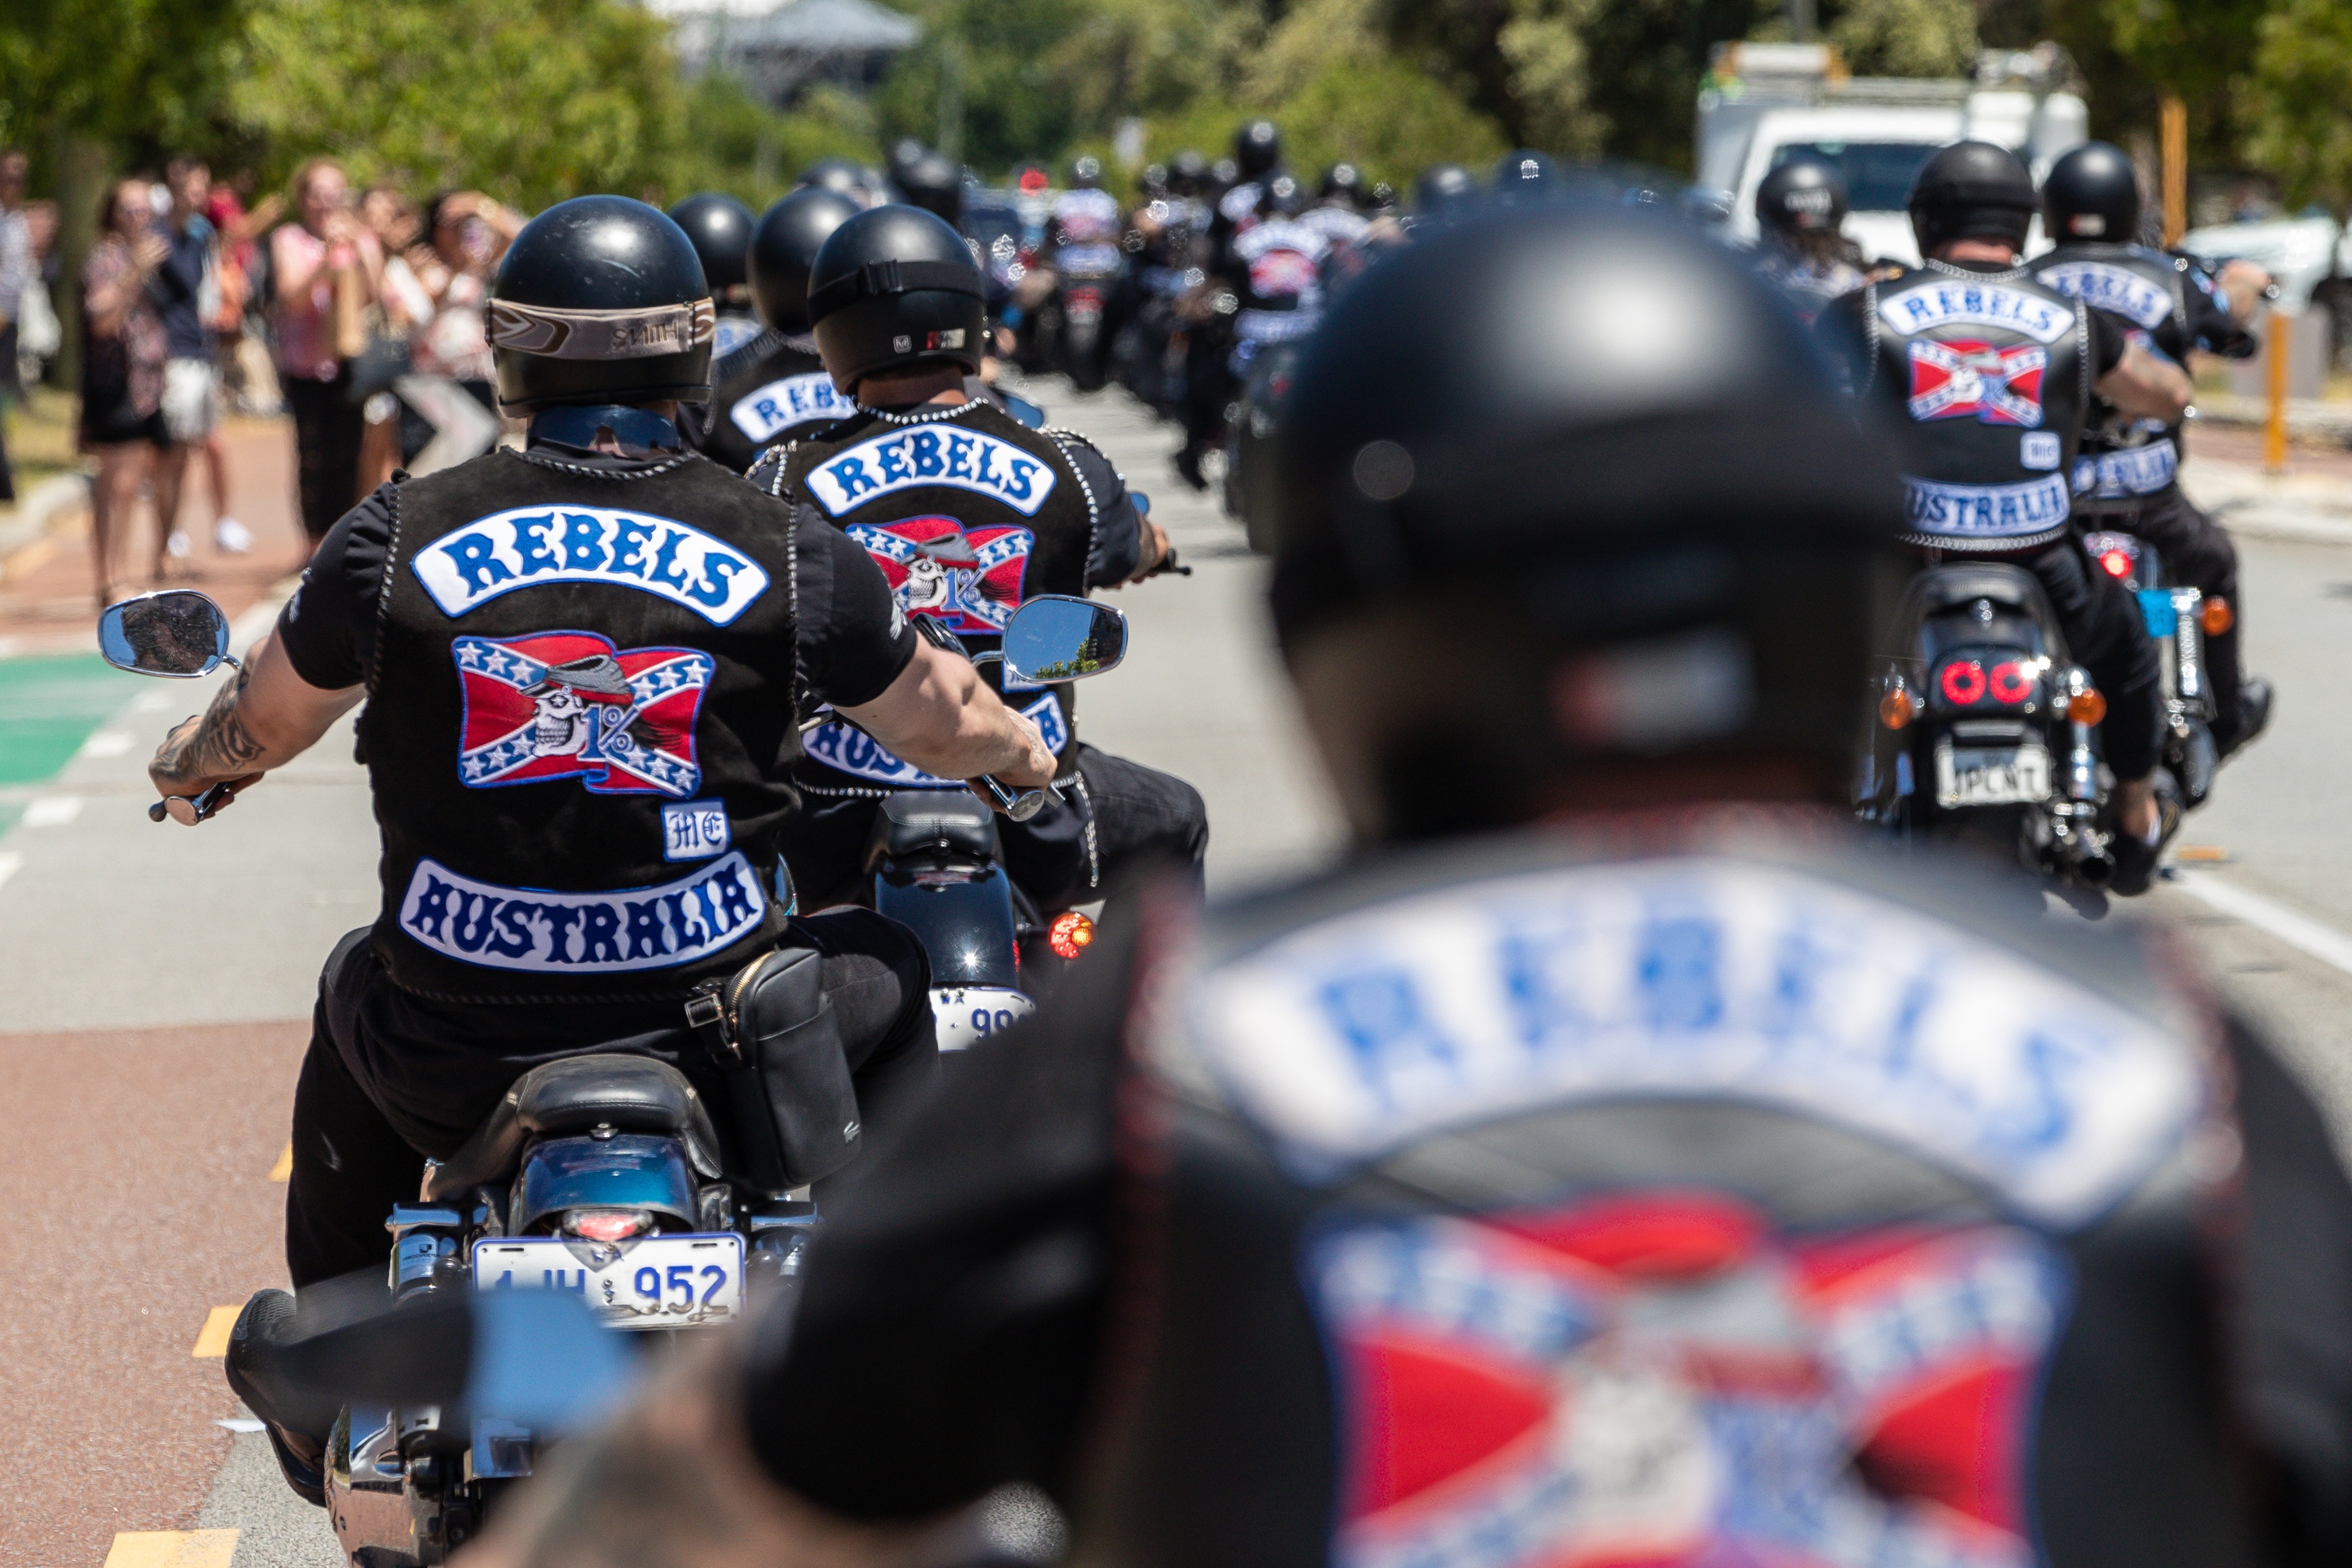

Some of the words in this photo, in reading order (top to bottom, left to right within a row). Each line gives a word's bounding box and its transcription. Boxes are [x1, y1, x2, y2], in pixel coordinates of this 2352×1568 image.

[1905, 287, 2056, 330] REBELS
[825, 430, 1040, 503] REBELS
[440, 511, 748, 608] REBELS
[939, 567, 986, 611] 1%
[576, 704, 642, 762] 1%
[672, 810, 723, 849] MC
[405, 861, 758, 963] AUSTRALIA
[635, 1265, 729, 1314] 952
